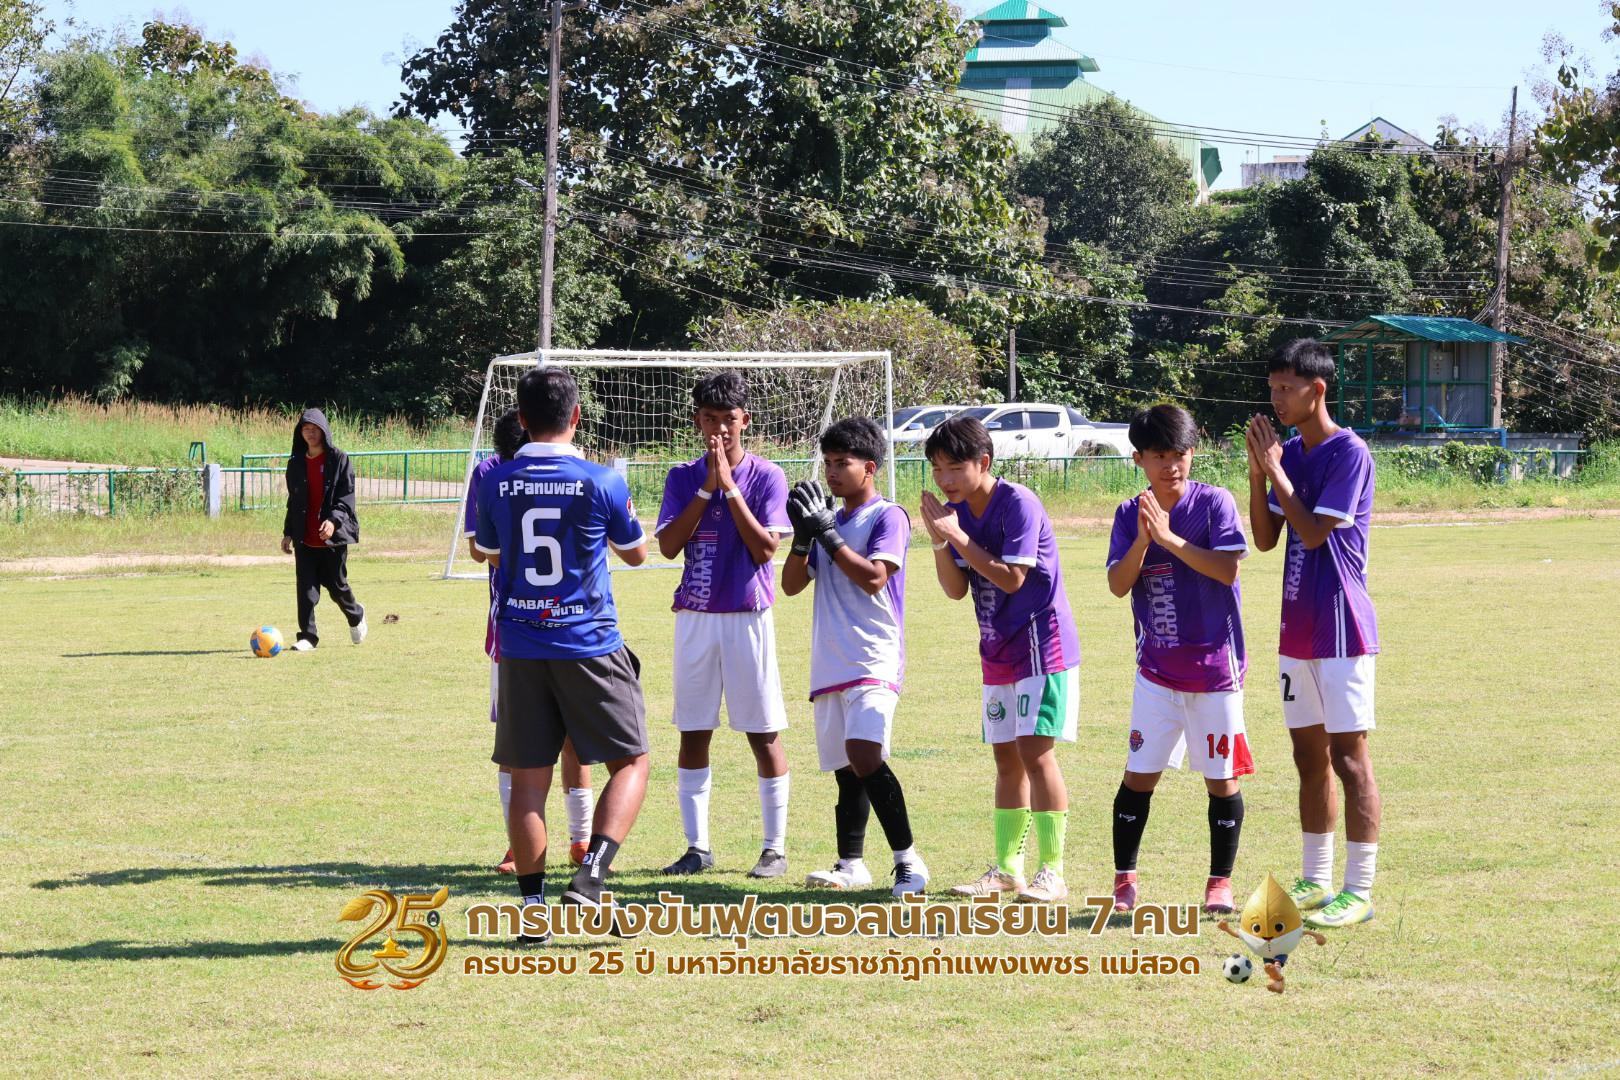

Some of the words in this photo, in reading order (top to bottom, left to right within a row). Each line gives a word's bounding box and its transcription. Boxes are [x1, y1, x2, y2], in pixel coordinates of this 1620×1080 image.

[498, 479, 585, 497] P.Panuwat
[521, 507, 564, 587] 5
[1281, 672, 1296, 702] 2
[1206, 733, 1230, 760] 14
